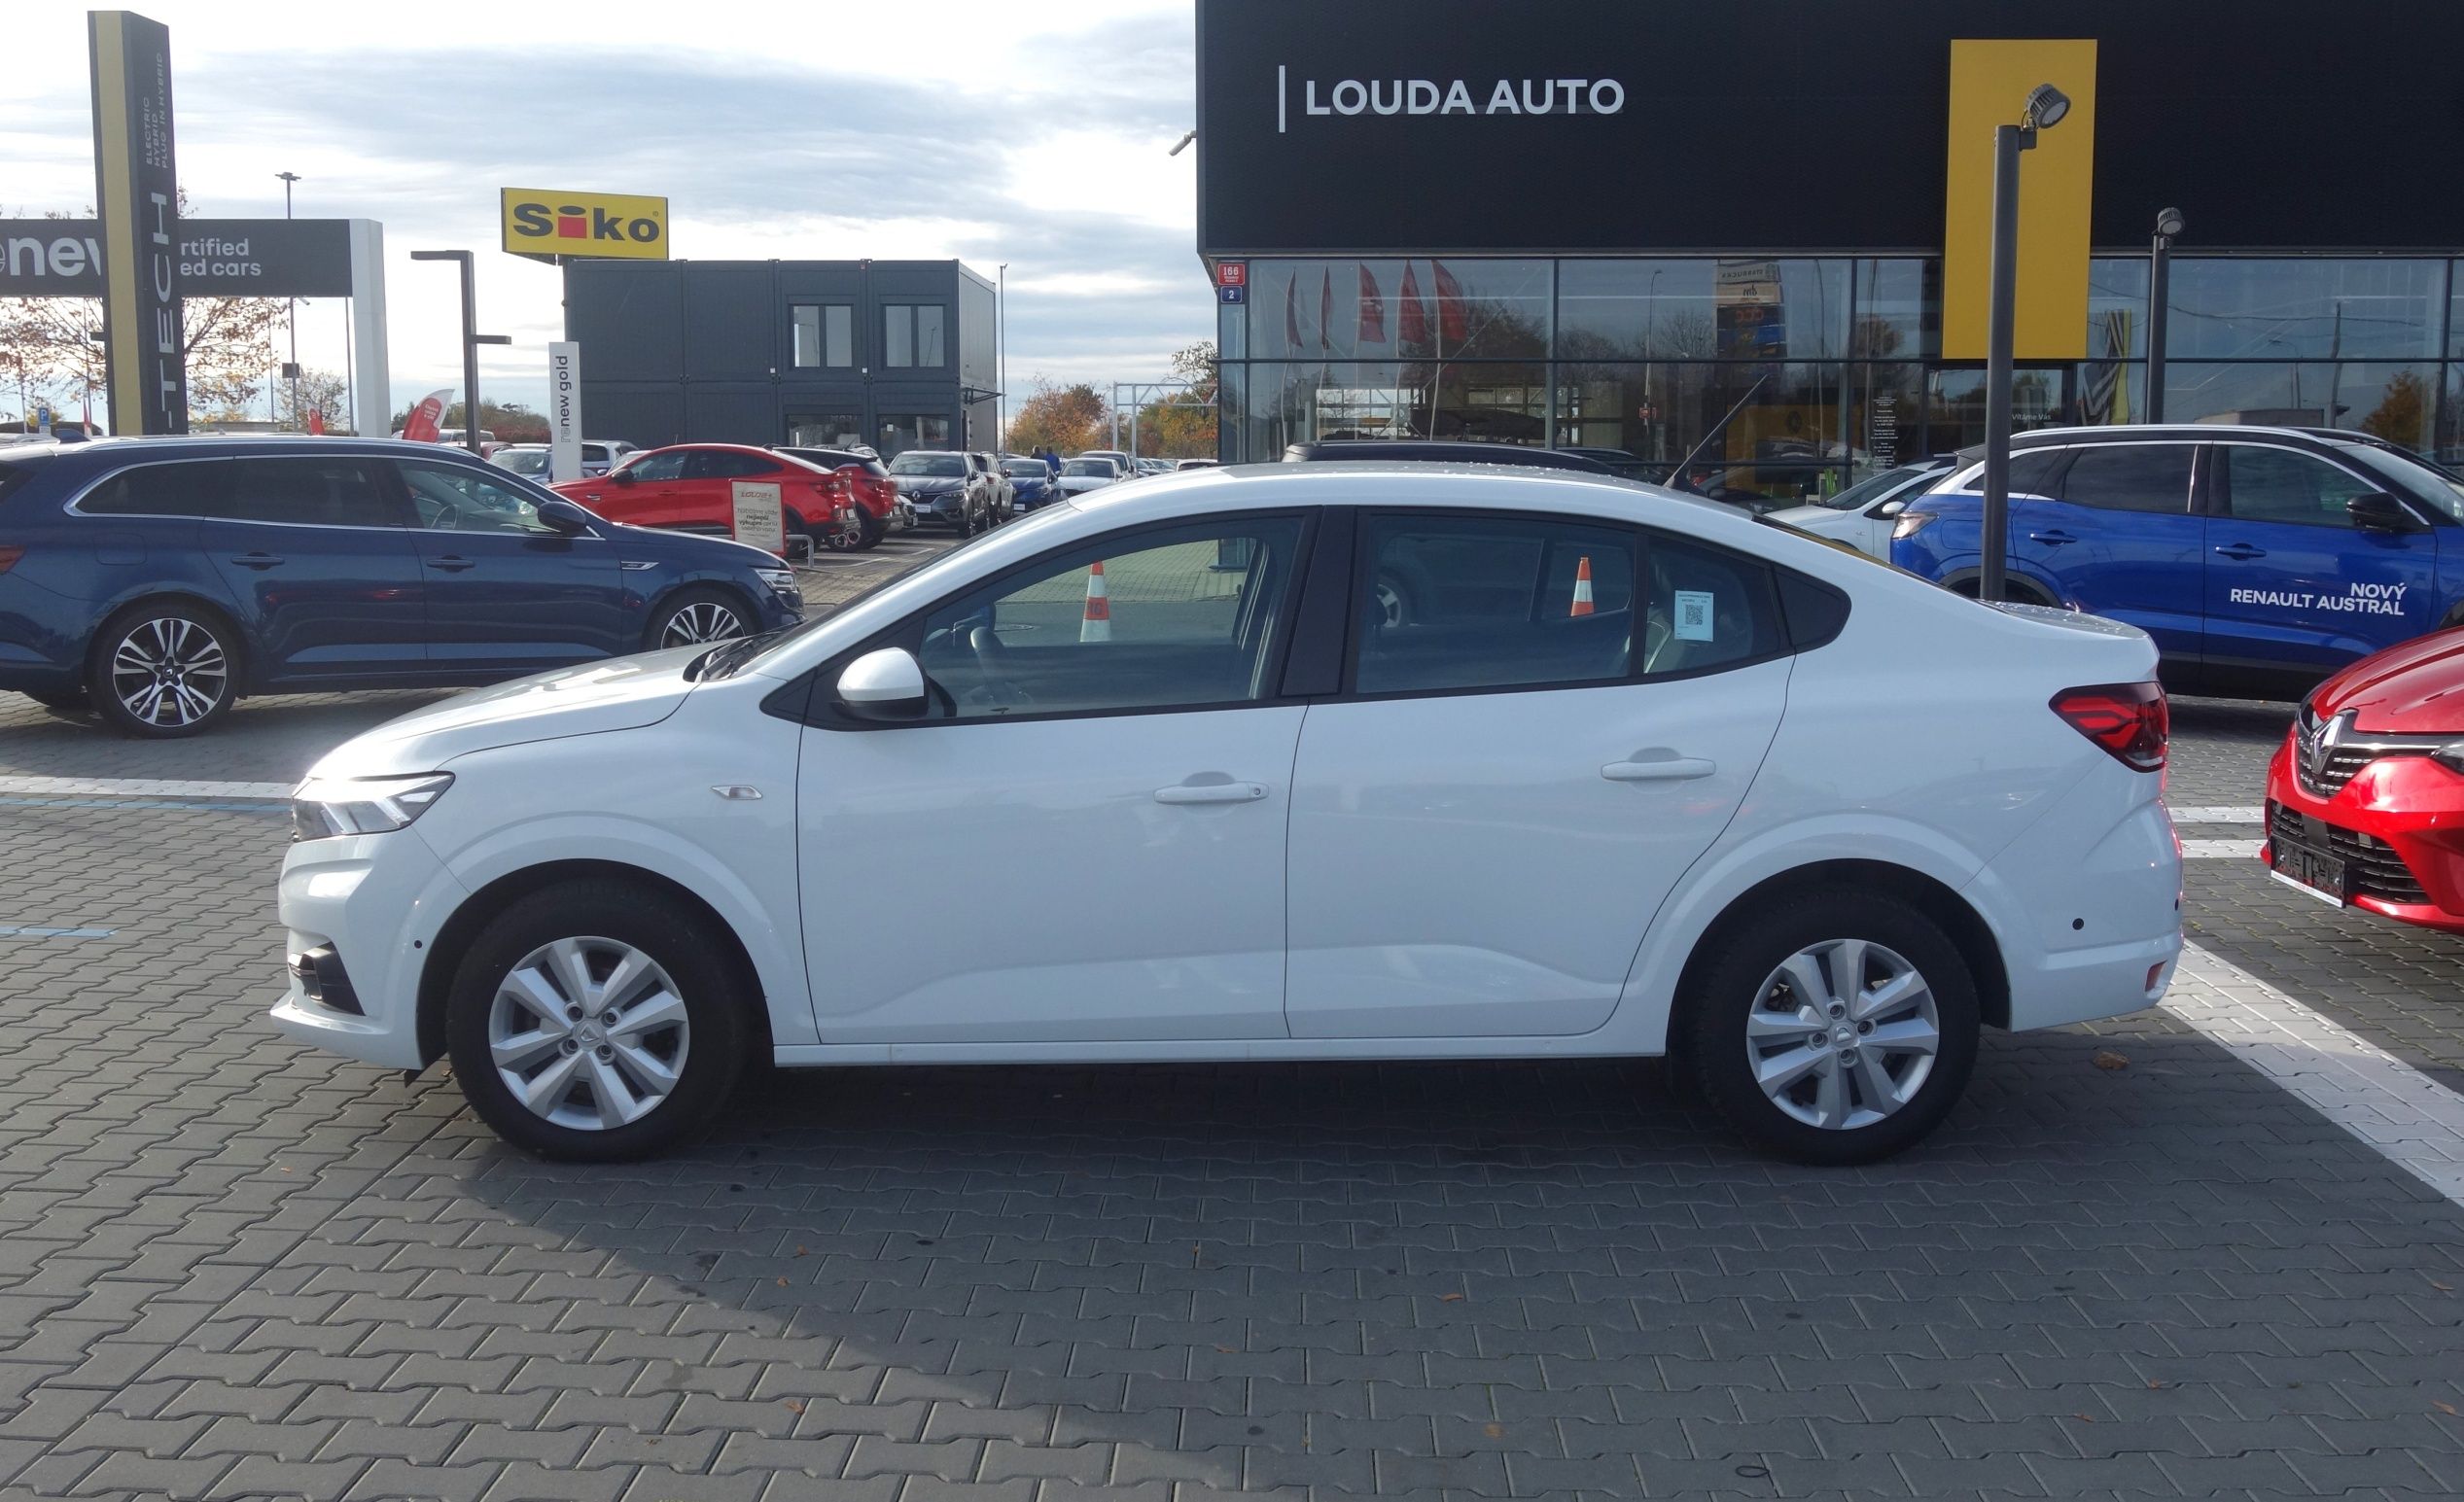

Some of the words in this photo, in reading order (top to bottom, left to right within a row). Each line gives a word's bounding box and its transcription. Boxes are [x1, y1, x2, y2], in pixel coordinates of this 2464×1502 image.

[1306, 80, 1476, 115] LOUDA
[1485, 79, 1625, 115] AUTO
[143, 96, 153, 165] ELECTRIC
[152, 113, 160, 167] HYBRID
[512, 202, 660, 243] Siko
[180, 237, 249, 257] rtified
[180, 258, 207, 276] ed
[211, 262, 262, 276] cars
[1223, 266, 1239, 276] 166
[1228, 290, 1235, 299] 2
[151, 192, 177, 429] -TECH
[555, 356, 572, 392] gold
[41, 409, 48, 420] P
[2230, 588, 2314, 609] RENAULT
[2316, 595, 2405, 616] AUSTRAL
[2350, 582, 2407, 601] NOVÝ
